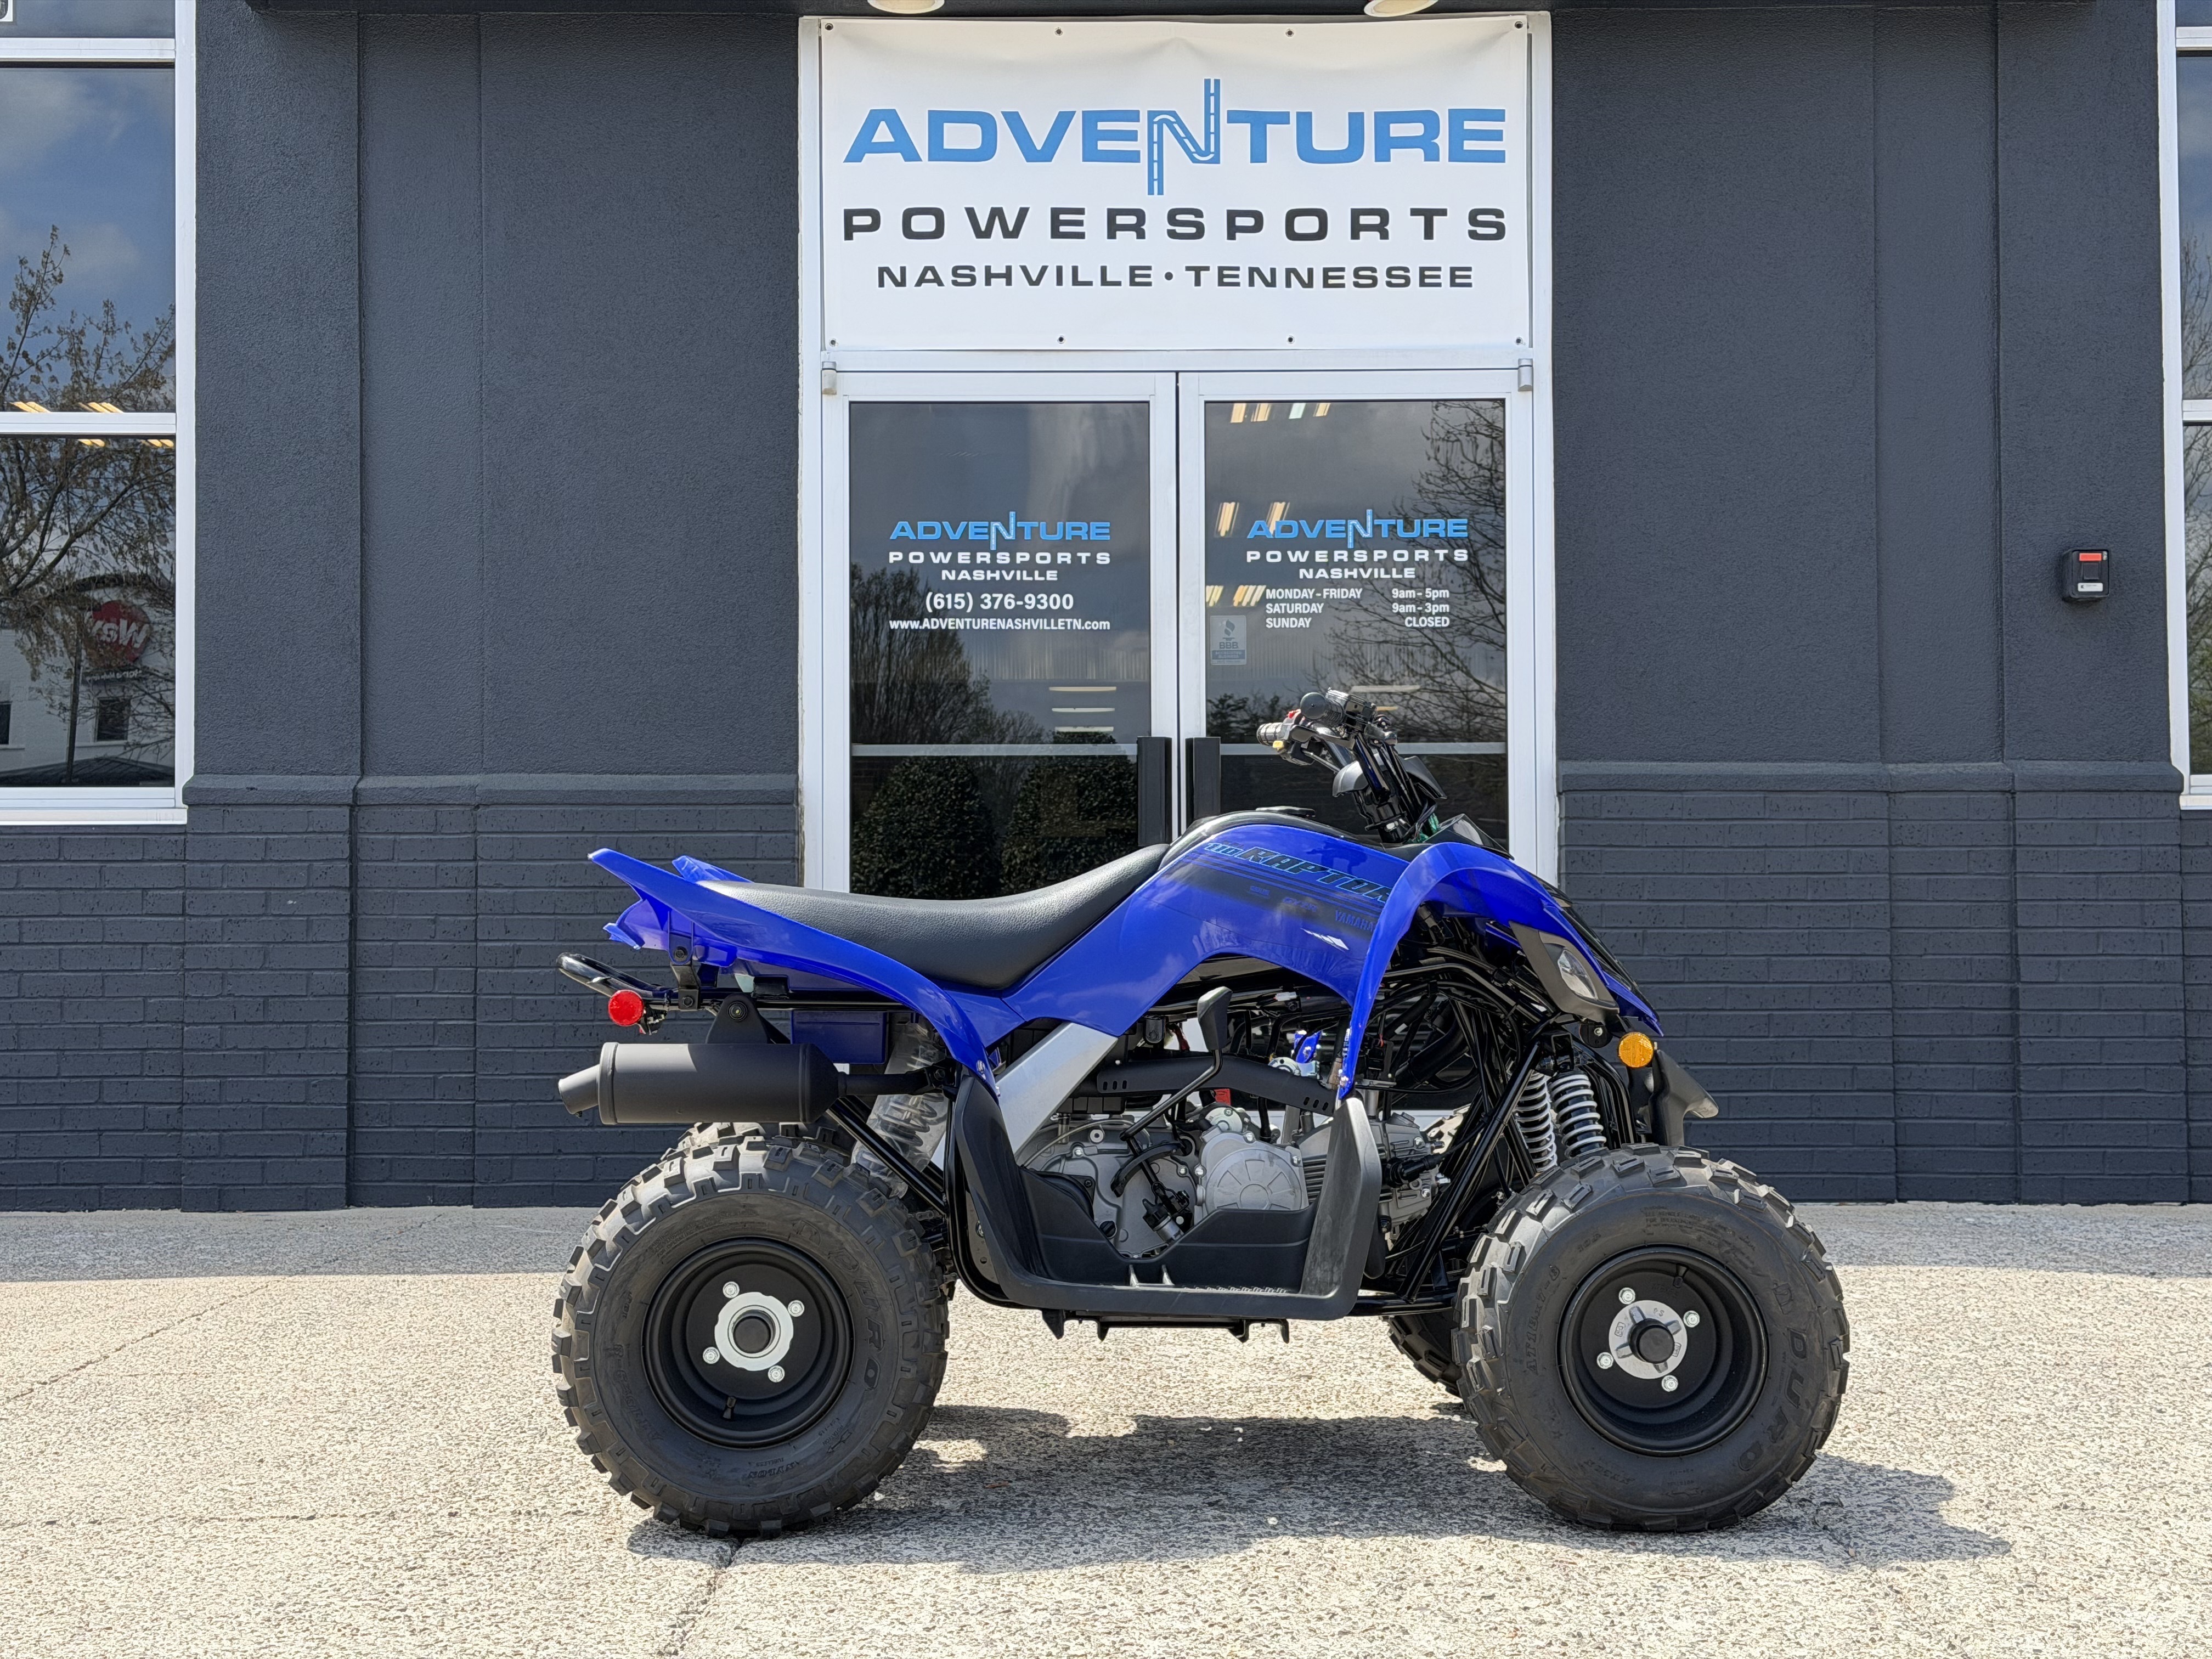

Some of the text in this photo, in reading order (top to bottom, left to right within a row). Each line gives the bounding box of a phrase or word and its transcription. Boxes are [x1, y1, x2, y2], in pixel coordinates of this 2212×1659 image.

[844, 78, 1506, 196] ADVENTURE
[843, 207, 1506, 241] POWERSPORTS
[878, 266, 1473, 289] NASHVILLE TENNESSEE
[889, 511, 1111, 550] ADVENTURE
[1246, 509, 1469, 549] ADVENTURE
[889, 551, 1111, 565] POWERSPORTS
[1246, 549, 1469, 563] POWERSPORTS
[941, 569, 1058, 581] NASHVILLE
[1299, 567, 1416, 579] NASHVILLE
[926, 591, 1074, 613] (615) 376-9300
[1266, 602, 1325, 614] SATURDAY
[889, 618, 1111, 630] www.ADVENTURENASHVILLETN.com
[1266, 616, 1450, 629] SUNDAY CLOSED
[1738, 1326, 1808, 1471] DURO
